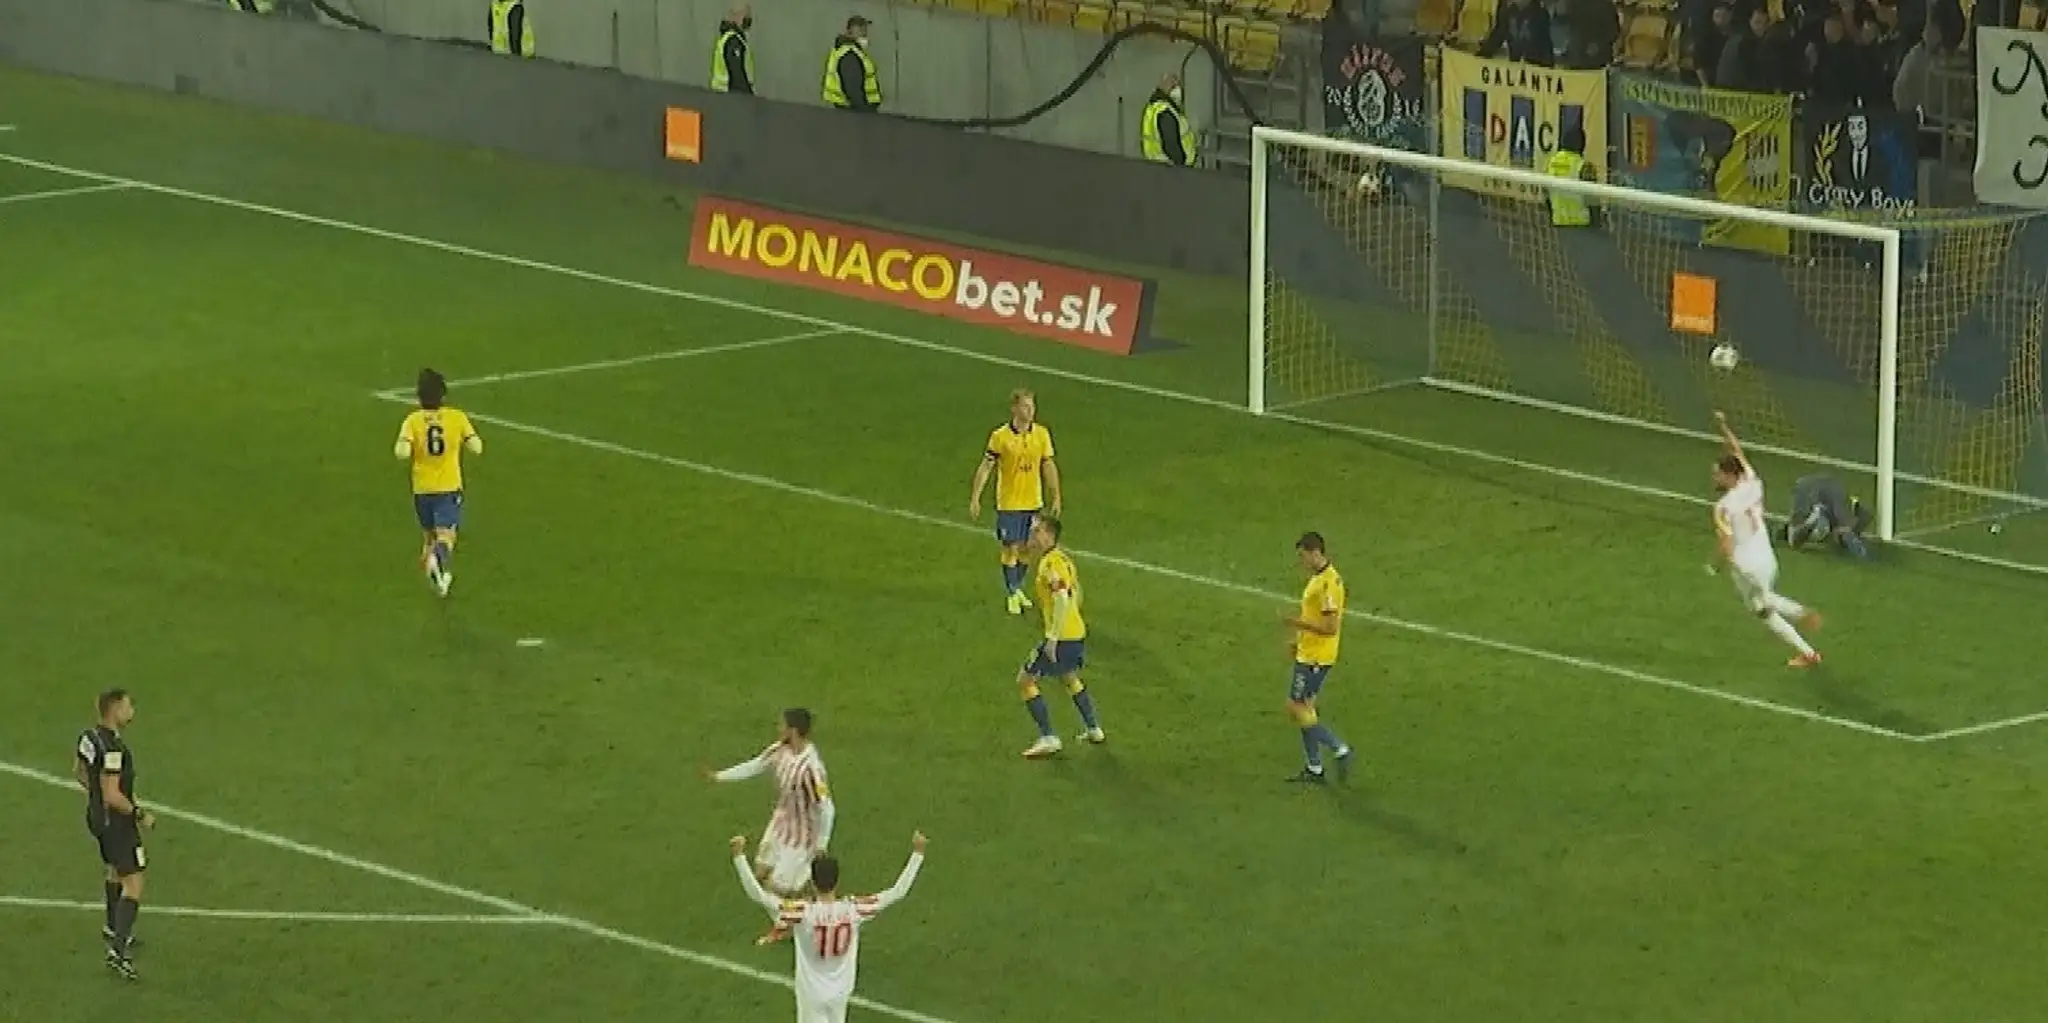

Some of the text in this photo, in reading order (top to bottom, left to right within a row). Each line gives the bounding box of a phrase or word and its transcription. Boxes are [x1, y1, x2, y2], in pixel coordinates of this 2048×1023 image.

[1490, 112, 1554, 154] DAC
[707, 212, 1117, 337] MONACObet.sk
[427, 424, 445, 456] 6
[814, 923, 852, 959] 10
